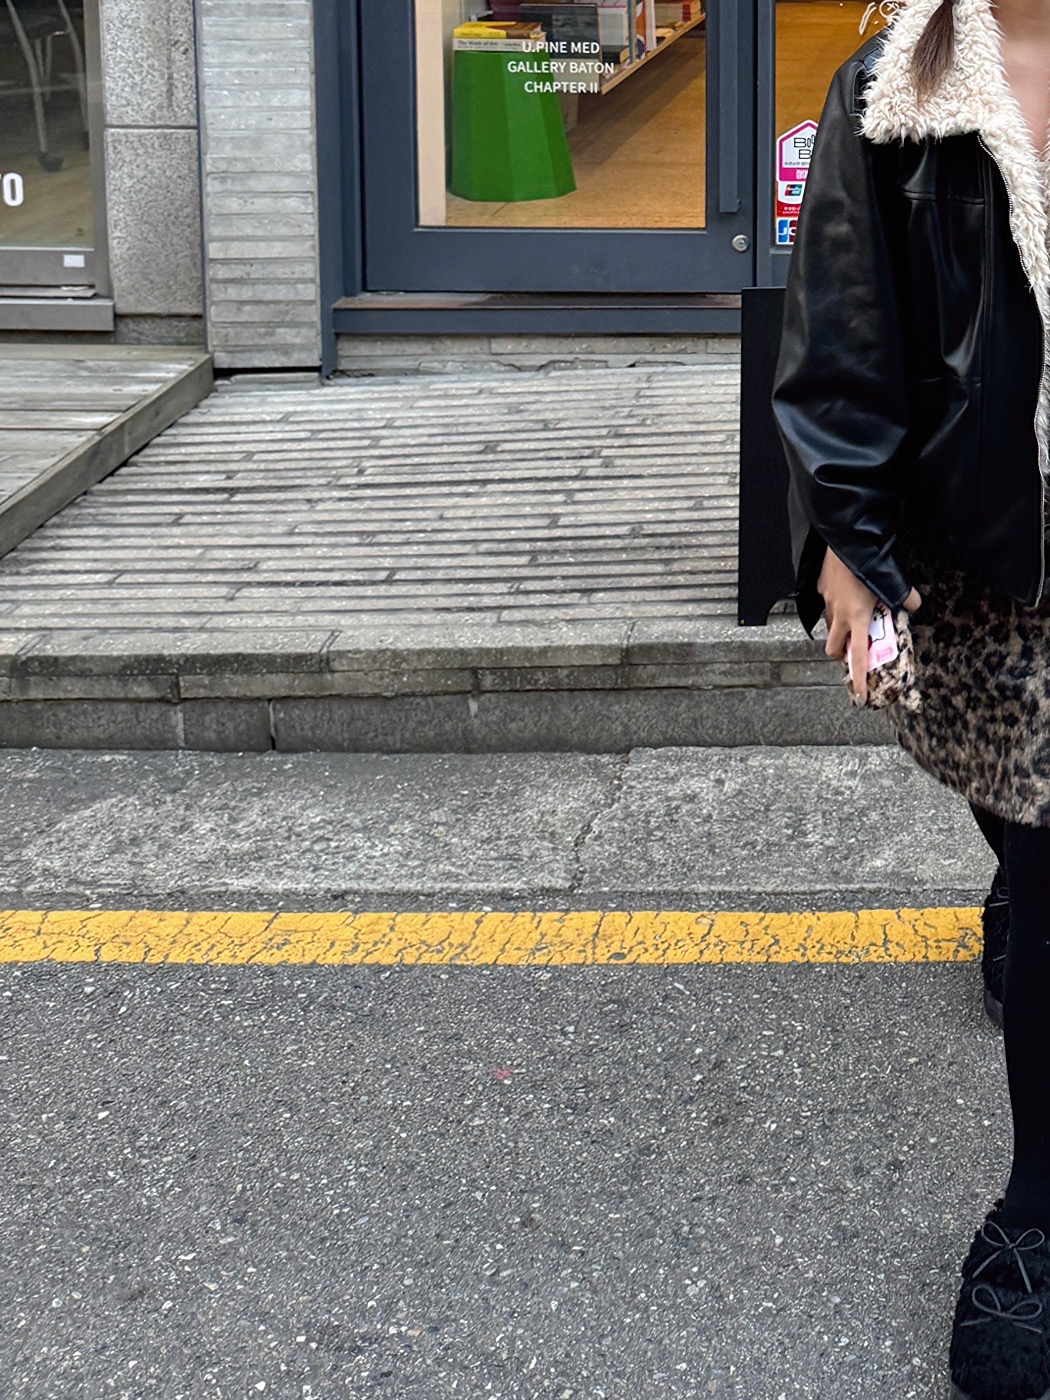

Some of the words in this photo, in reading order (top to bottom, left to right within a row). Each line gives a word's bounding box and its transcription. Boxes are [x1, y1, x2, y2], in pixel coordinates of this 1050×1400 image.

[571, 42, 600, 54] MED
[507, 61, 567, 73] GALLERY
[569, 62, 614, 74] BATON
[524, 81, 587, 93] CHAPTER
